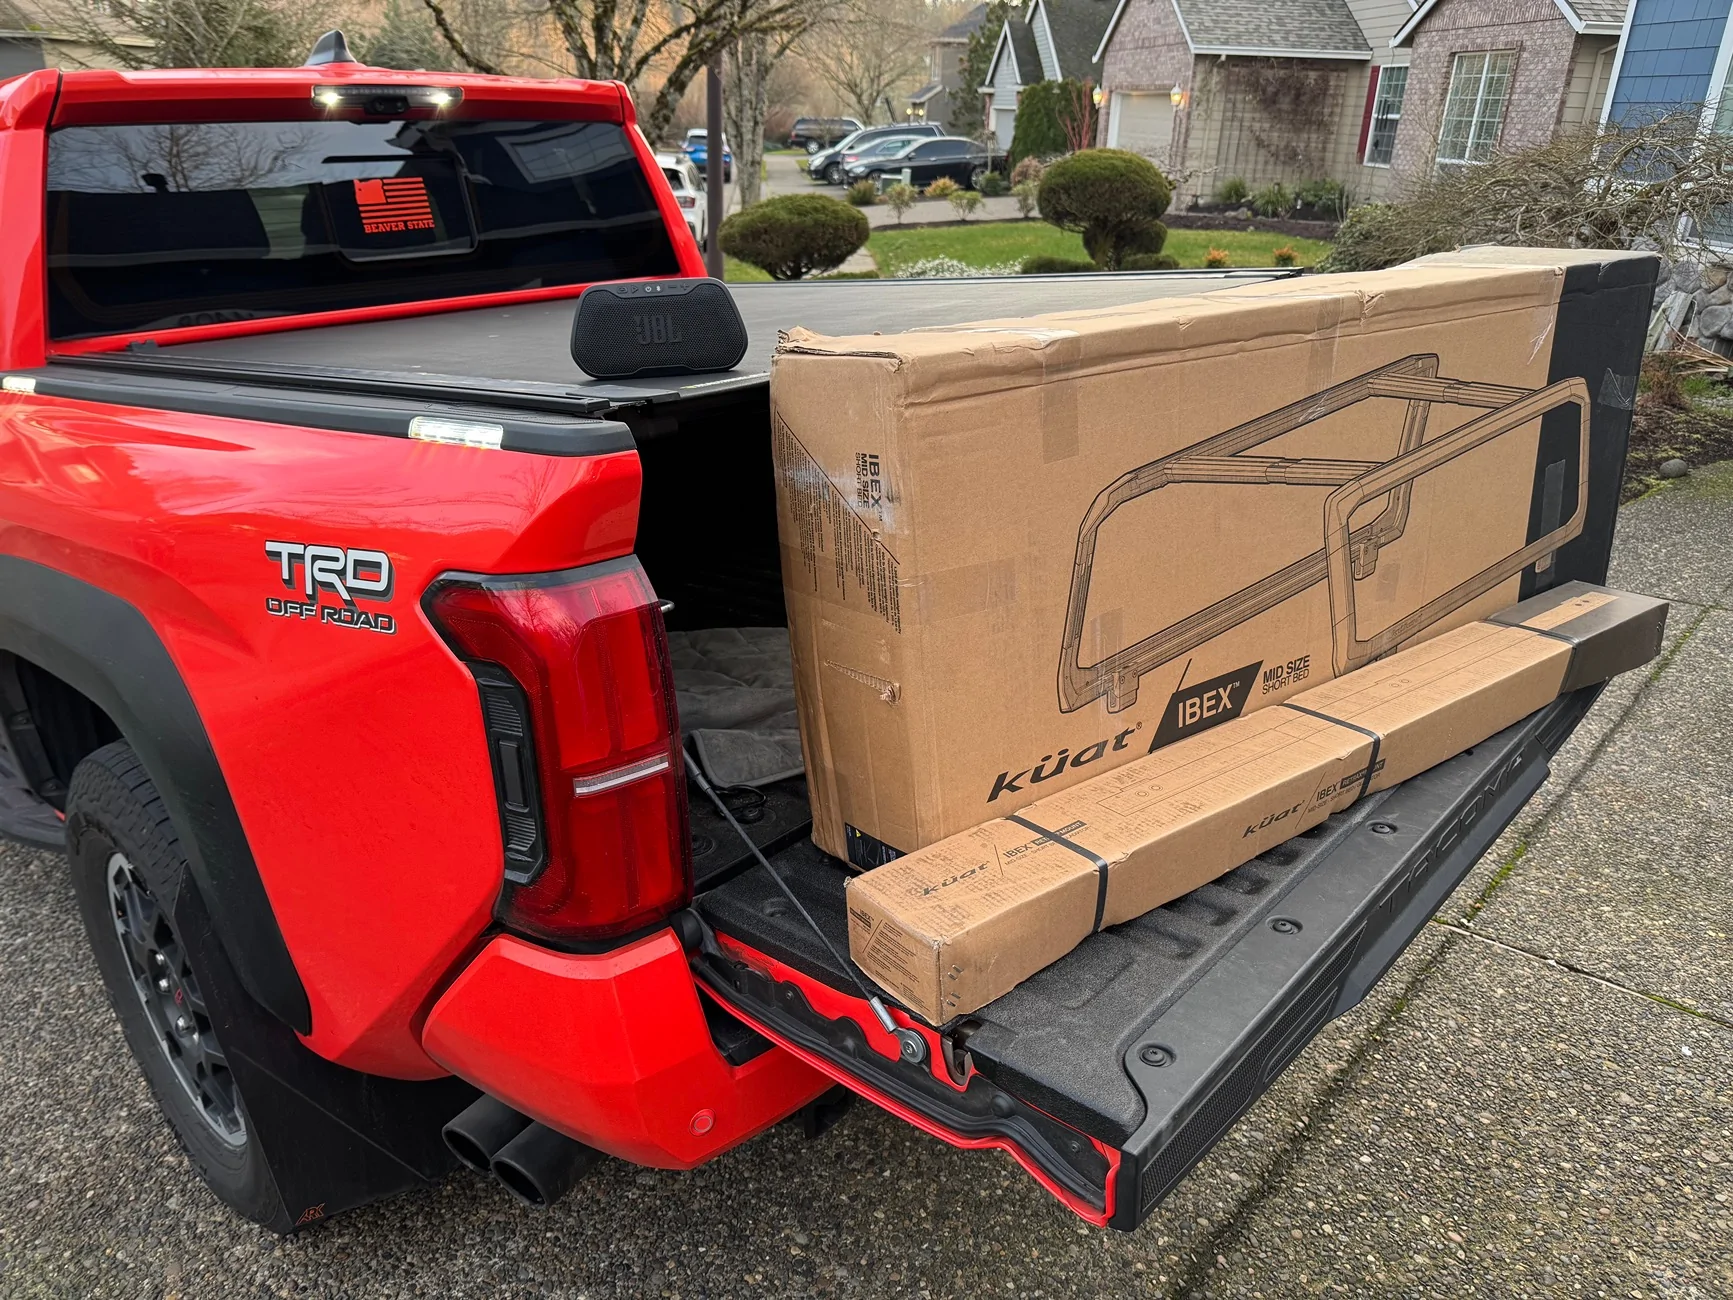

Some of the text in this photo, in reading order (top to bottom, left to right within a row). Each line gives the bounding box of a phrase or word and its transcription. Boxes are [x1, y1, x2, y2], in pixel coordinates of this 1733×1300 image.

[363, 219, 435, 233] BEAVER STATE
[633, 314, 683, 346] JBL
[860, 453, 870, 509] MID SIZE
[264, 539, 396, 605] TRD
[265, 597, 398, 635] OFF ROAD
[1262, 668, 1310, 695] SHORT BED
[1263, 654, 1311, 685] MID SIZE
[1379, 748, 1525, 913] TACOMA
